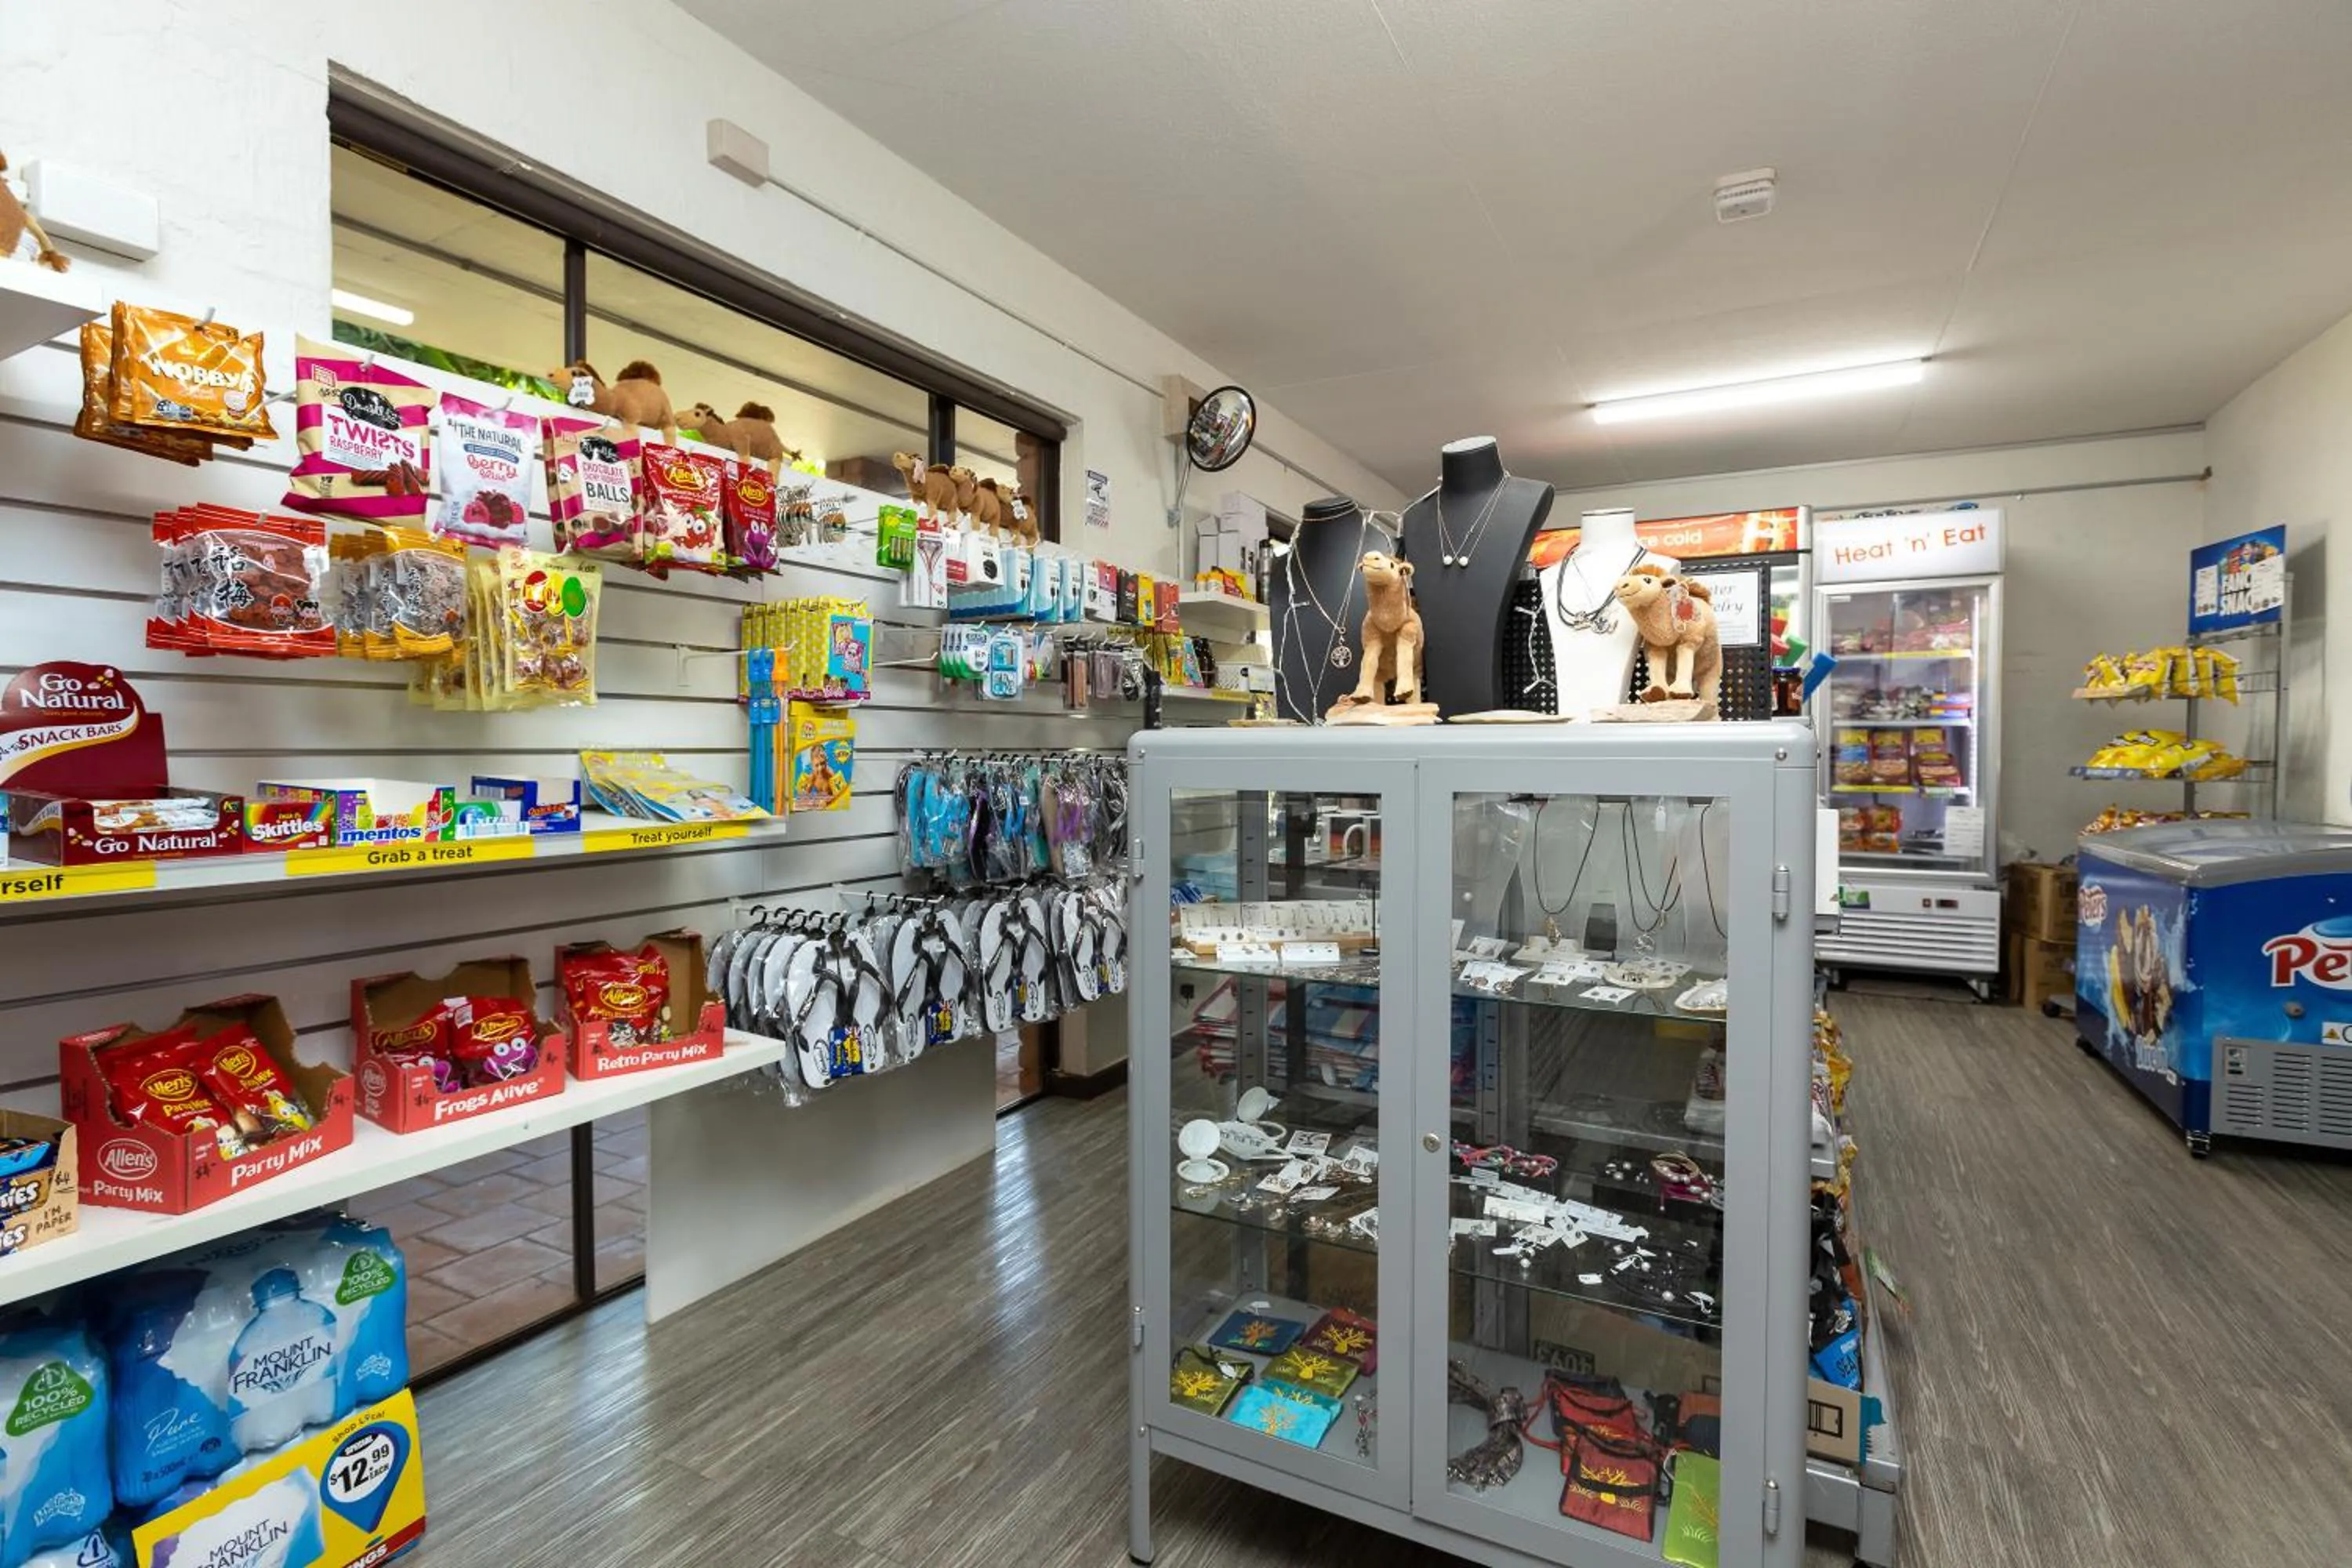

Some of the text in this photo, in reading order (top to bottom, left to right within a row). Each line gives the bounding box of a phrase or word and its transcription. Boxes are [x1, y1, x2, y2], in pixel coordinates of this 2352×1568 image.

[329, 435, 383, 459] RASPBERRY
[586, 481, 630, 503] BALLS
[1640, 530, 1703, 546] ce cold
[1835, 541, 1893, 565] Heat
[1944, 524, 1986, 546] Eat
[40, 673, 82, 691] Go
[20, 687, 125, 710] Natural
[19, 728, 82, 750] SNACK
[86, 723, 123, 736] BARS
[251, 818, 324, 840] Skittles
[341, 826, 421, 842] mentos
[631, 826, 713, 844] Treat yourself
[95, 830, 217, 854] Go Natural
[368, 845, 472, 865] Grab a treat
[2, 875, 64, 894] rself
[598, 1044, 708, 1072] Retro Party Mix
[434, 1081, 539, 1121] Frogs Alive
[104, 1149, 154, 1171] Allen's
[230, 1151, 285, 1186] Party
[288, 1135, 322, 1162] Mix
[93, 1180, 164, 1203] Party Mix
[36, 1212, 72, 1234] PAPER
[342, 1276, 390, 1298] RECYCLED
[254, 1336, 314, 1369] MOUNT
[234, 1342, 331, 1393] FRANKLIN
[24, 1385, 78, 1412] 100%
[16, 1395, 85, 1427] RECYCLED
[209, 1519, 270, 1563] MOUNT
